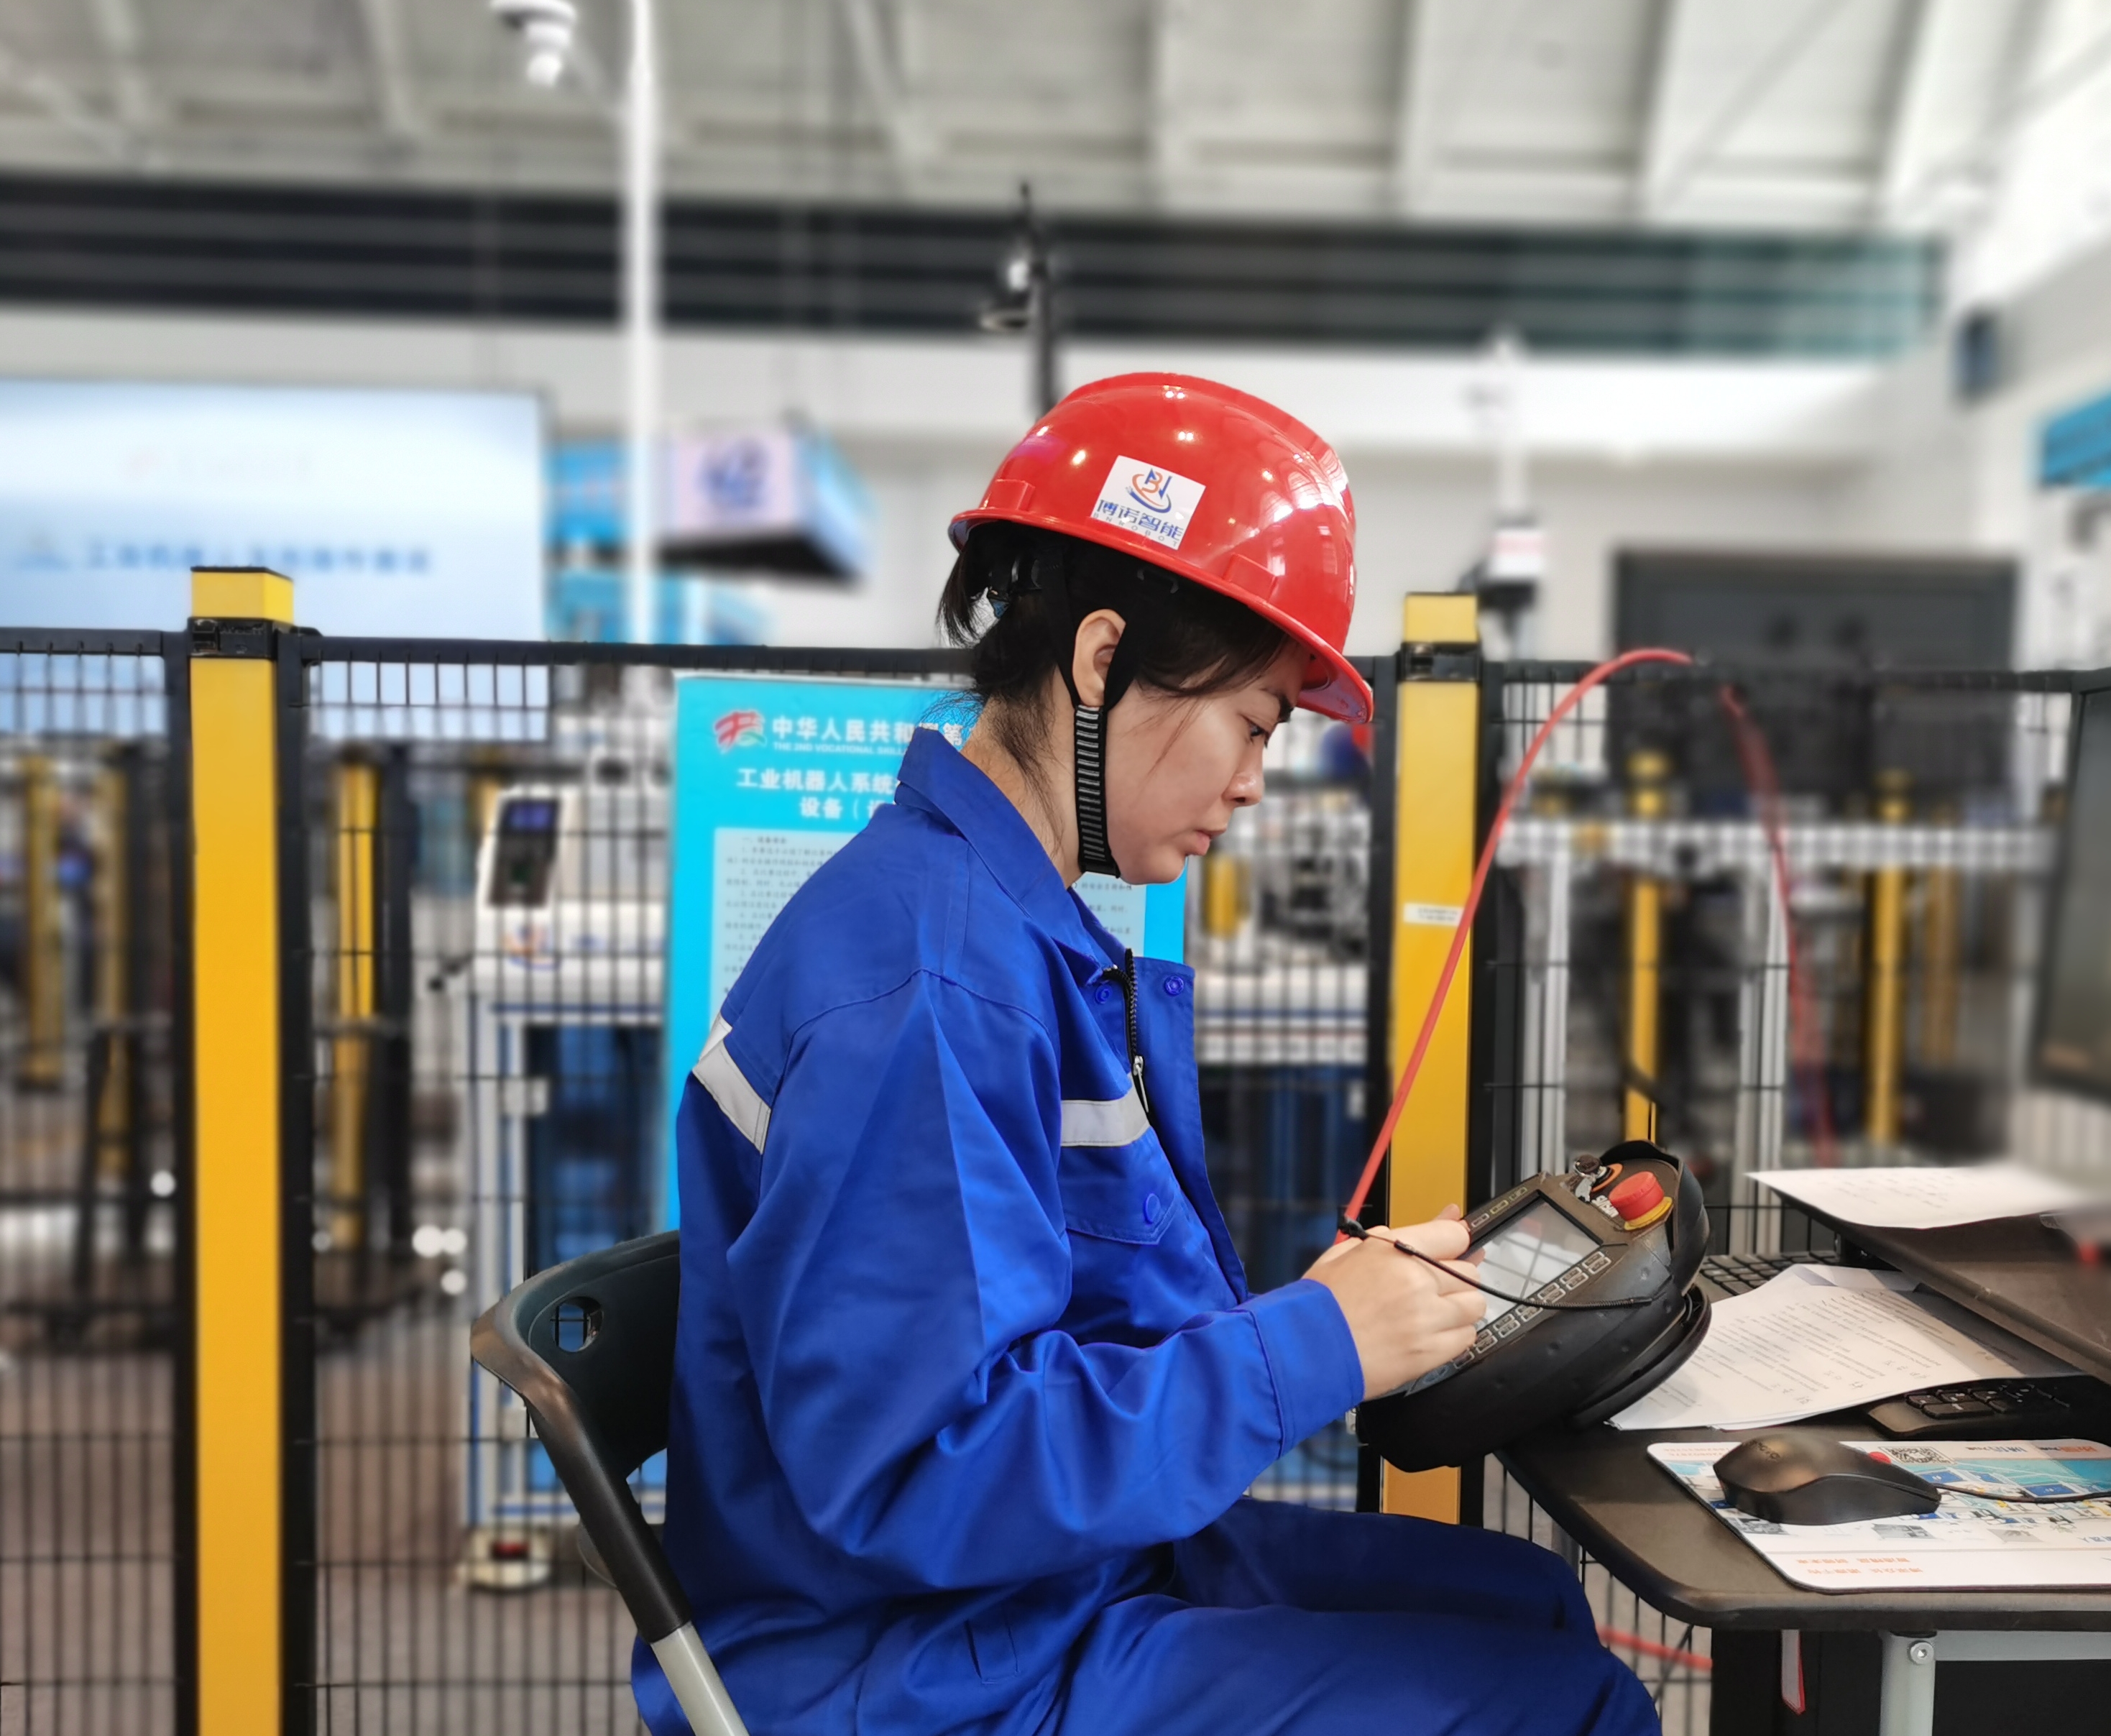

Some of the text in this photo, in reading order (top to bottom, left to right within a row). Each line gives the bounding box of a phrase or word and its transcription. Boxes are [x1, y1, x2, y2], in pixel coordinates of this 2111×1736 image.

[1096, 499, 1184, 540] 博诺智能
[736, 768, 901, 795] 工业机器人系统
